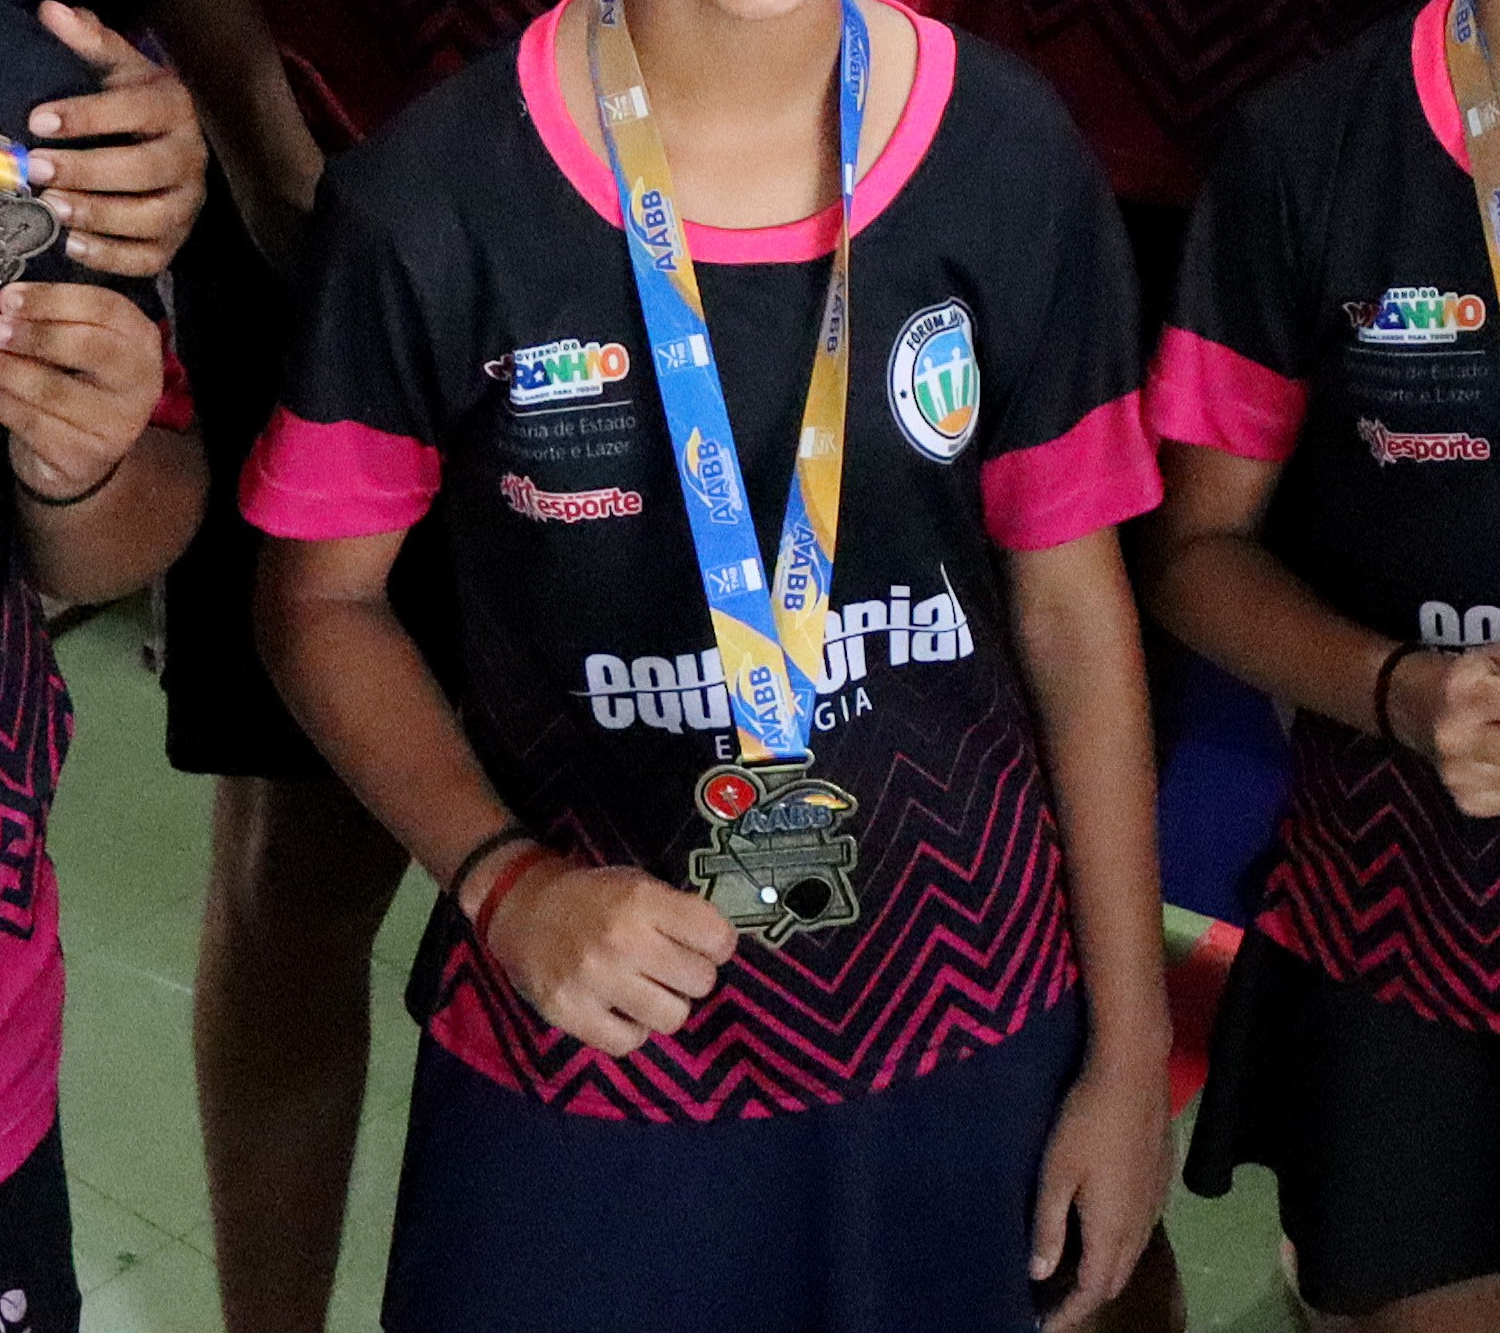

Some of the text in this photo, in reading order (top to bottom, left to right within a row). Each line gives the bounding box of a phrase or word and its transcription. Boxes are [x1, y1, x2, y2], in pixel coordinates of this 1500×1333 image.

[639, 188, 678, 272] AABB
[906, 313, 946, 352] FÓRUM
[696, 438, 739, 524] AABB
[1387, 434, 1489, 460] esporte
[537, 490, 641, 521] esporte
[784, 529, 815, 611] AABB
[749, 665, 789, 750] AABB
